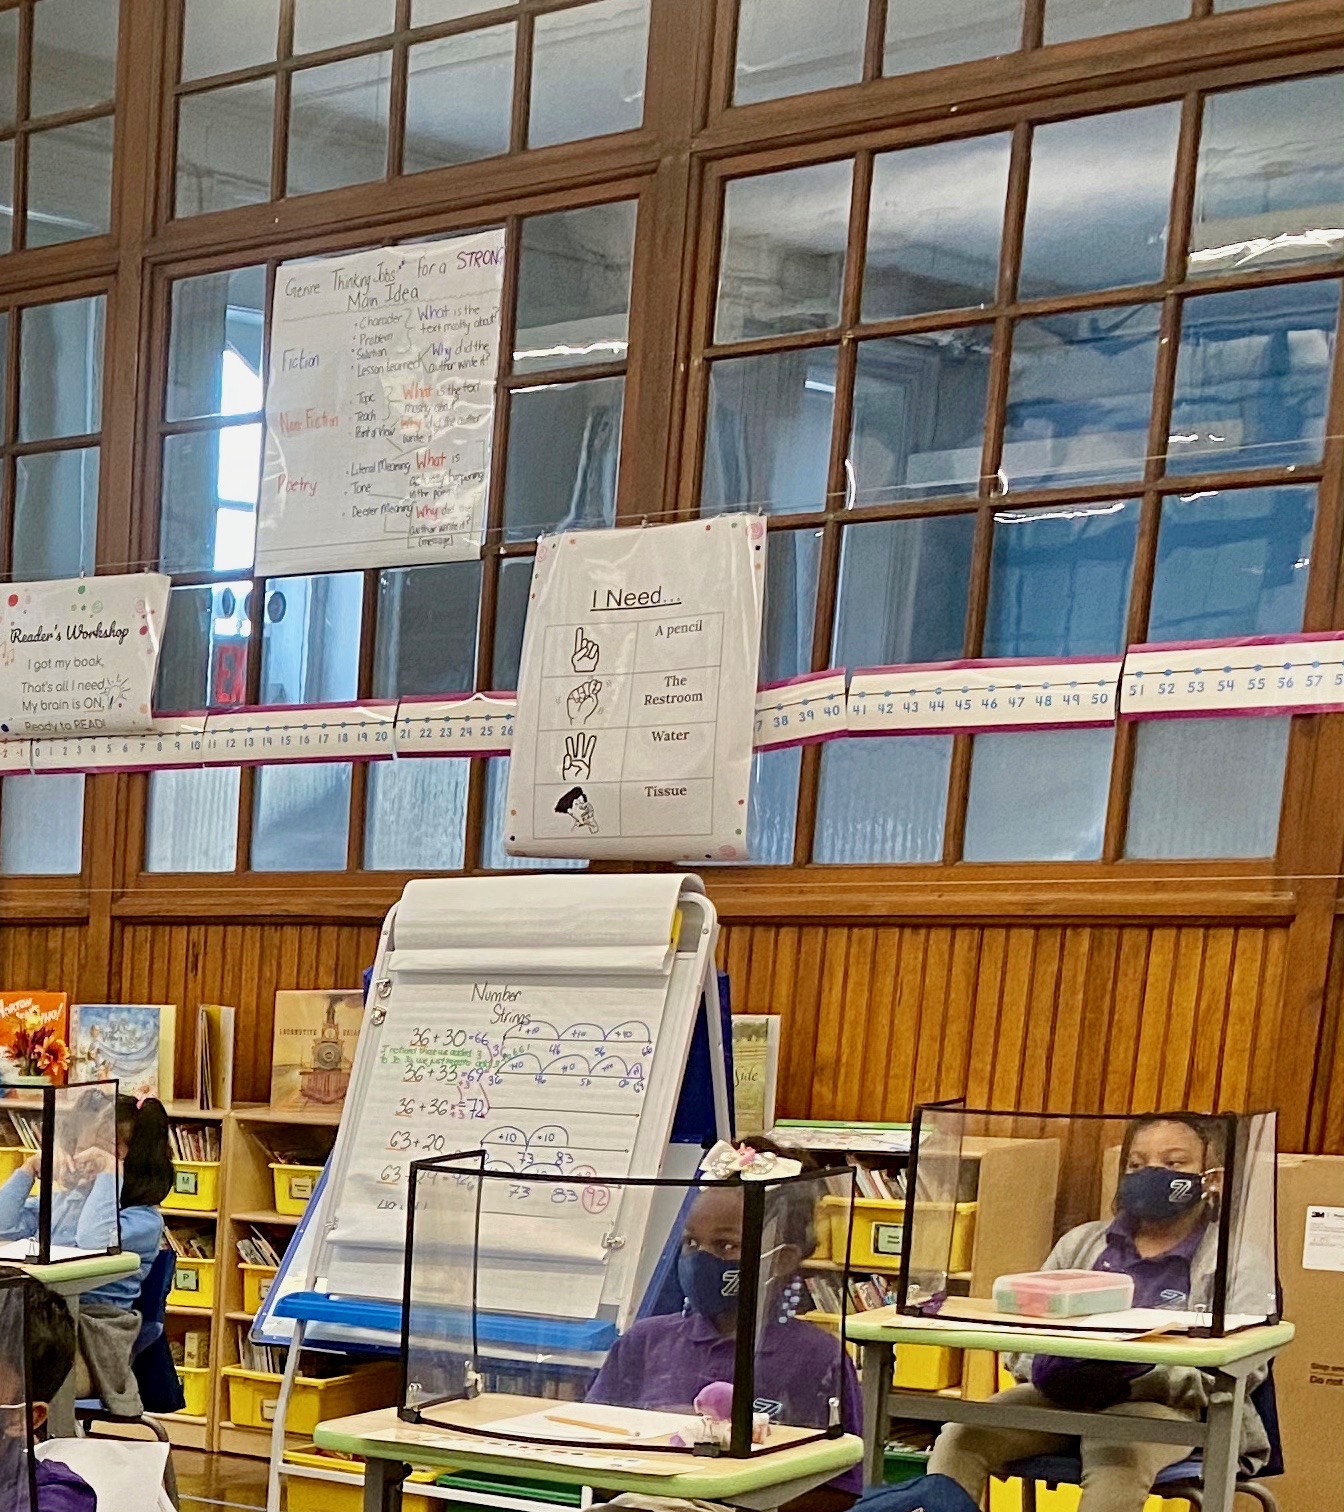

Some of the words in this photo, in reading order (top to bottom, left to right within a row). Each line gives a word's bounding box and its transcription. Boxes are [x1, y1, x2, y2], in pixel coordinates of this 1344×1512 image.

[439, 262, 447, 275] a
[385, 282, 419, 303] Idea
[417, 307, 449, 321] What
[454, 309, 462, 317] is
[464, 306, 480, 315] the
[282, 349, 319, 372] Fiction
[416, 452, 447, 469] What
[278, 476, 317, 495] Poetry
[592, 590, 597, 608] I
[11, 624, 62, 644] Reader's
[66, 621, 129, 645] Workshop
[655, 625, 664, 637] A
[667, 619, 703, 639] pencil
[28, 659, 31, 670] I
[34, 659, 53, 672] got
[55, 659, 71, 671] my
[22, 681, 53, 694] That's
[56, 681, 69, 692] all
[665, 675, 687, 688] The
[1091, 693, 1108, 705] 50
[1158, 683, 1175, 695] 52
[1187, 681, 1205, 693] 53
[1216, 680, 1235, 692] 54
[1247, 678, 1265, 690] 55
[1277, 677, 1294, 689] 56
[1305, 675, 1323, 687] 57
[22, 701, 38, 716] My
[41, 699, 69, 710] brain
[72, 698, 81, 709] is
[644, 691, 703, 706] Restroom
[25, 721, 57, 732] Ready
[60, 720, 72, 730] to
[652, 730, 690, 742] Water
[644, 785, 687, 798] Tissue
[471, 983, 522, 1003] Number
[490, 1003, 531, 1029] Strings
[410, 1029, 430, 1046] 36
[443, 1029, 467, 1047] 30
[549, 1043, 561, 1055] 46
[403, 1065, 423, 1082] 36
[437, 1064, 458, 1082] 33
[488, 1075, 503, 1086] 36
[396, 1099, 414, 1115] 36
[428, 1098, 447, 1115] 36
[390, 1131, 411, 1148] 63
[422, 1134, 445, 1150] 20
[518, 1151, 534, 1164] 73
[381, 1165, 401, 1181] 63
[509, 1184, 531, 1198] 73
[551, 1188, 578, 1203] 83
[587, 1188, 606, 1207] 92
[182, 1273, 190, 1282] P
